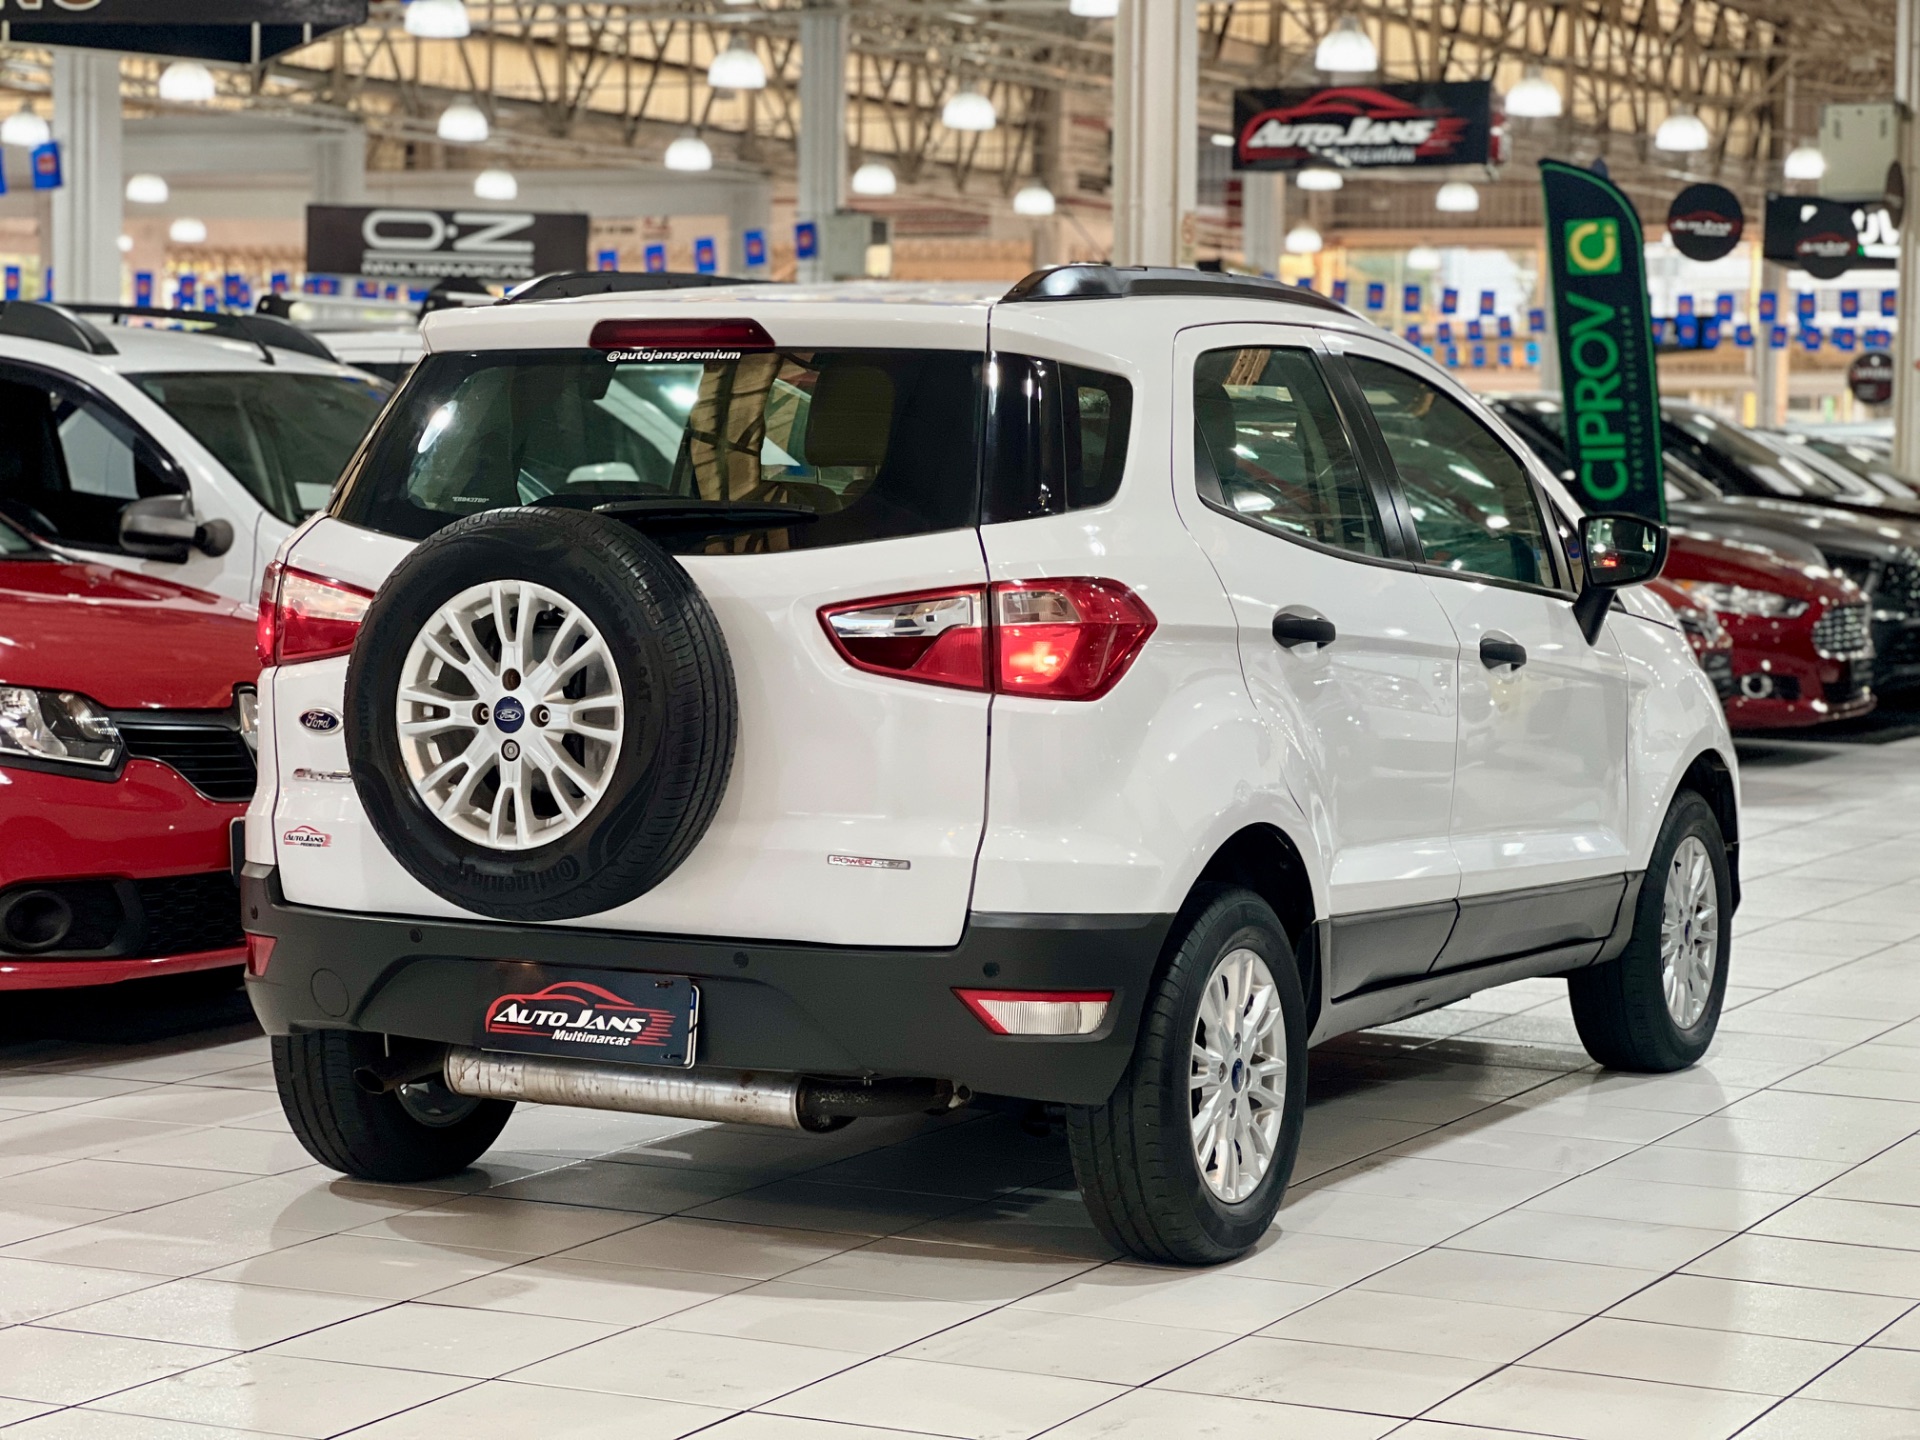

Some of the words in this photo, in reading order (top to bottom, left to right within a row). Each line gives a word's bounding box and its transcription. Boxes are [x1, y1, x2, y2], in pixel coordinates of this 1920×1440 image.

[606, 349, 741, 362] @autojanspremium
[1566, 291, 1629, 501] CIPROV
[306, 713, 331, 729] Ford
[552, 1028, 632, 1047] Multimarcas
